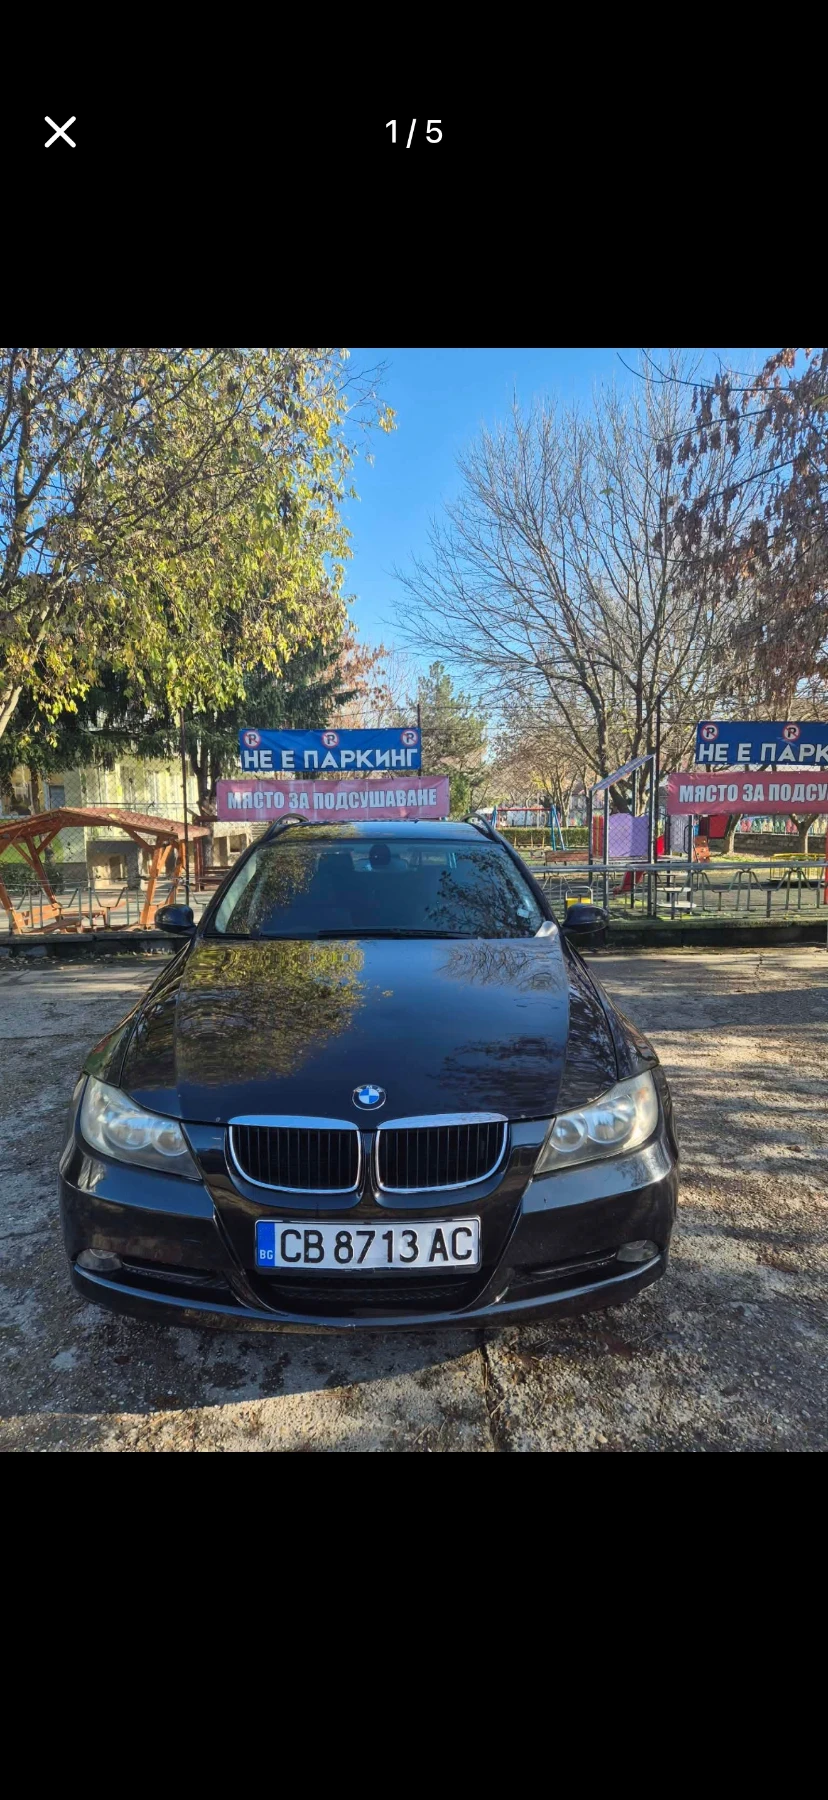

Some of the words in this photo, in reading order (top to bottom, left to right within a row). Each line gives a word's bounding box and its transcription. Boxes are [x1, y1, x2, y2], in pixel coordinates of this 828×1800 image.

[244, 750, 273, 768] НЕ
[282, 750, 295, 768] Е
[304, 748, 418, 769] ПАРКИНГ
[698, 743, 729, 762] НЕ
[737, 743, 751, 762] Е
[761, 743, 828, 763] ПАРК
[227, 791, 284, 810] МЯСТО
[288, 791, 309, 809] ЗА
[313, 788, 437, 811] ПОДСУШАВАНЕ
[679, 784, 738, 803] МЯСТО
[742, 784, 764, 802] ЗА
[769, 783, 828, 803] ПОДСУ
[259, 1250, 273, 1260] BG
[280, 1229, 325, 1264] CB
[333, 1230, 419, 1264] 8713
[428, 1226, 473, 1262] AC
